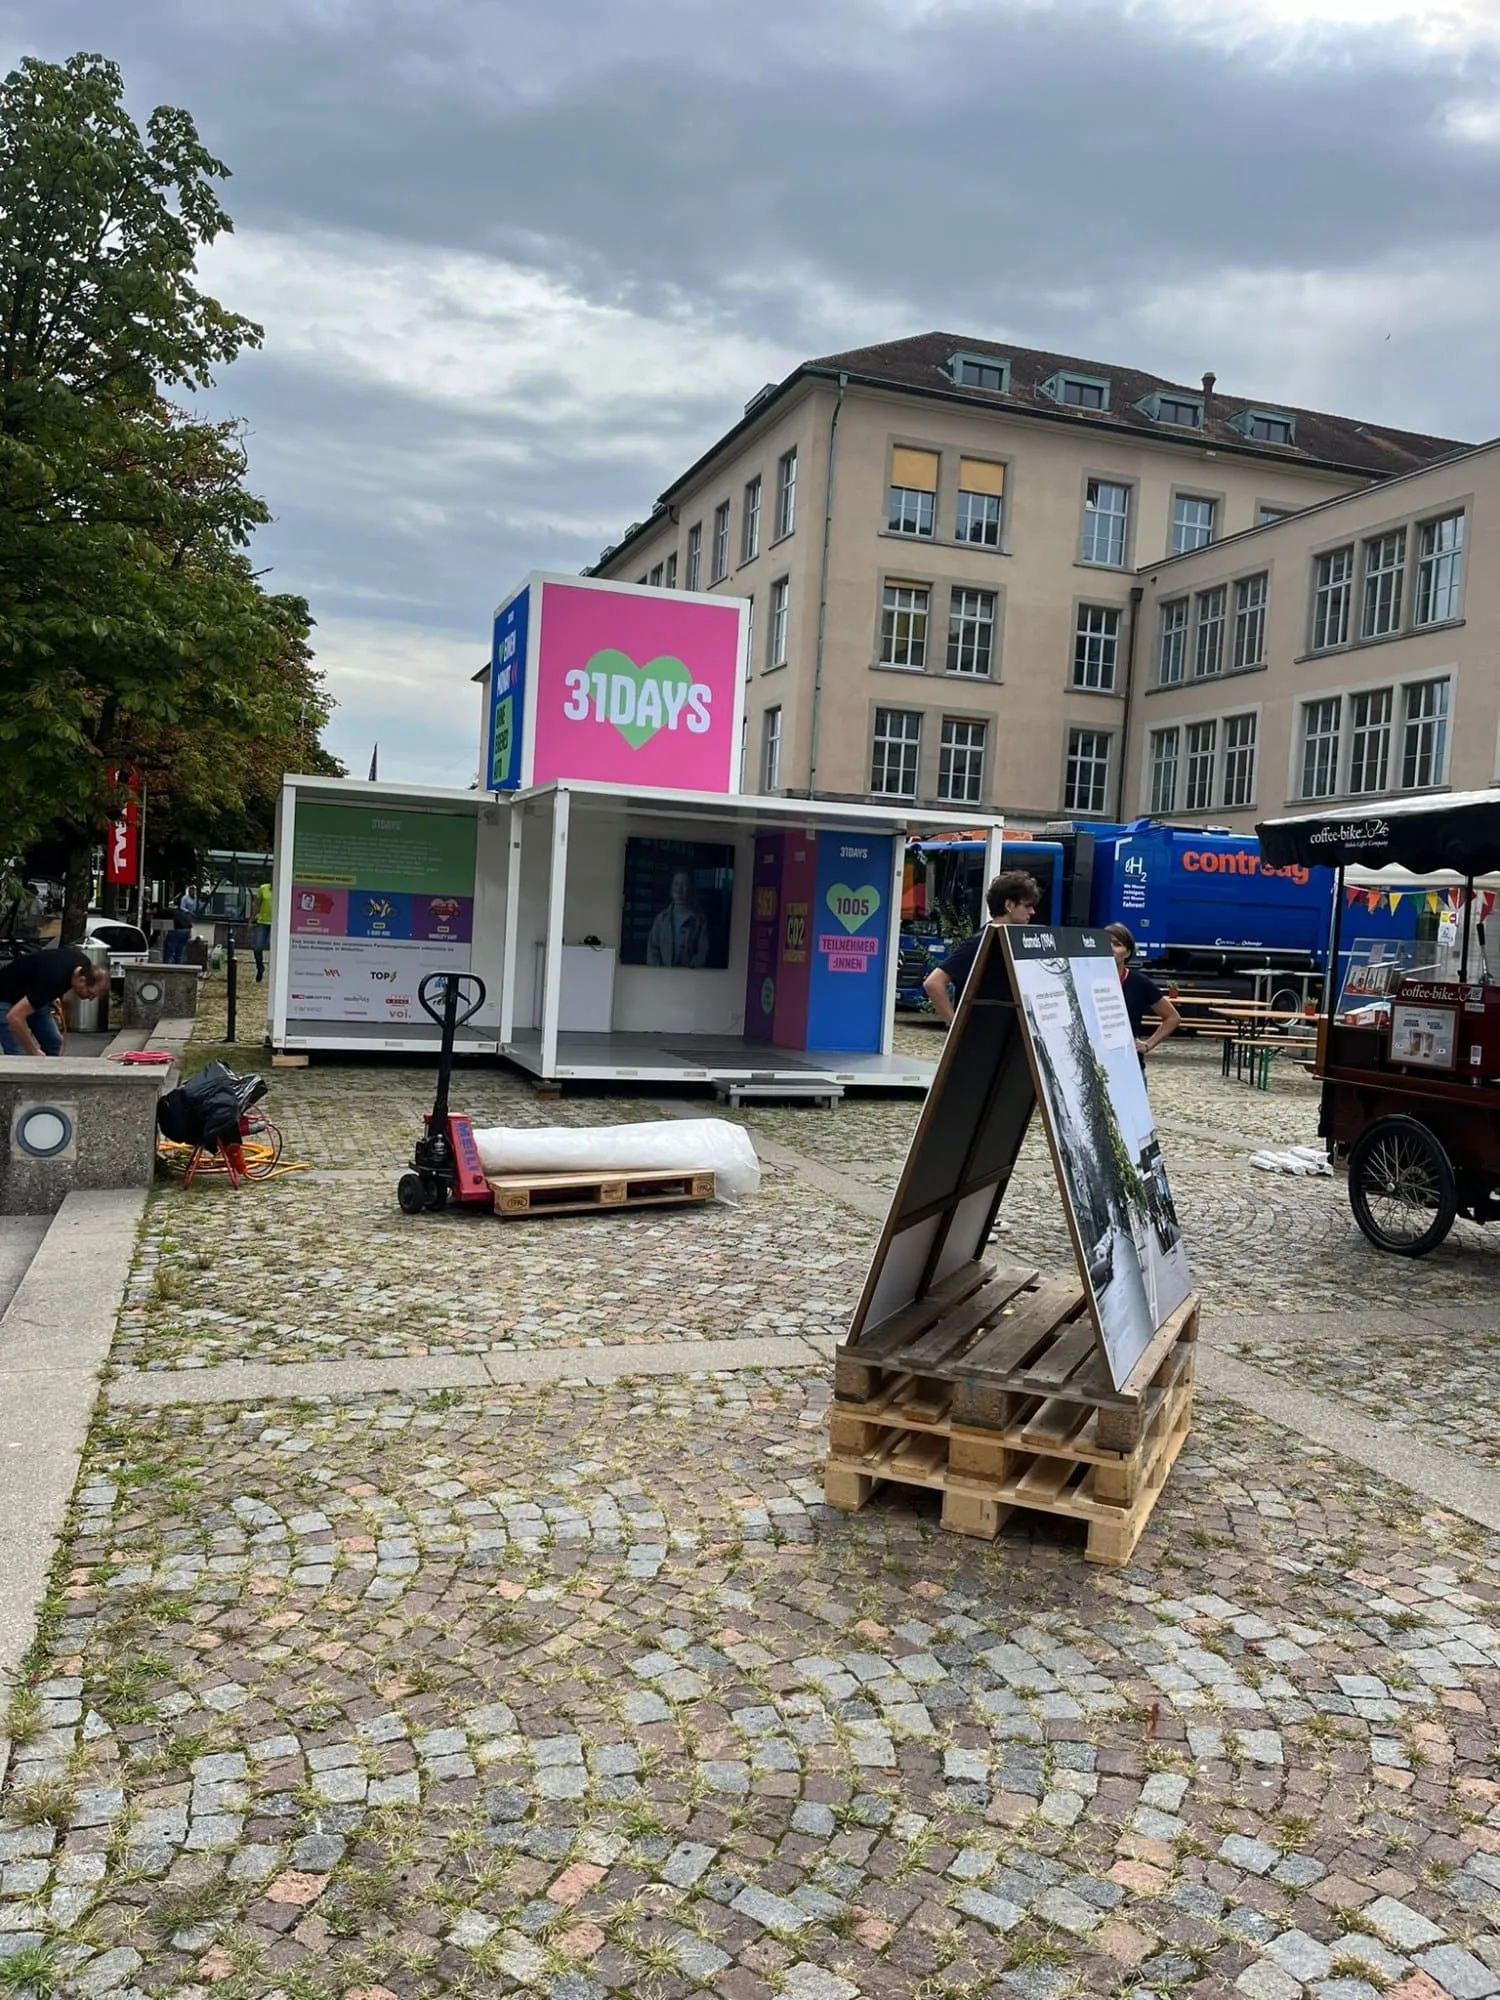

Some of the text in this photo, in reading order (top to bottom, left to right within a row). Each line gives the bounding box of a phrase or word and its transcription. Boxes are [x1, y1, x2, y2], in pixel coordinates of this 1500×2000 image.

[563, 669, 712, 733] 31DAYS
[1310, 824, 1363, 844] coffee-bike
[840, 846, 868, 859] 31DAYS
[837, 897, 870, 916] 1005
[822, 938, 876, 953] TEILNEHMER
[370, 971, 391, 981] TOP
[1401, 984, 1454, 1000] coffee-bike
